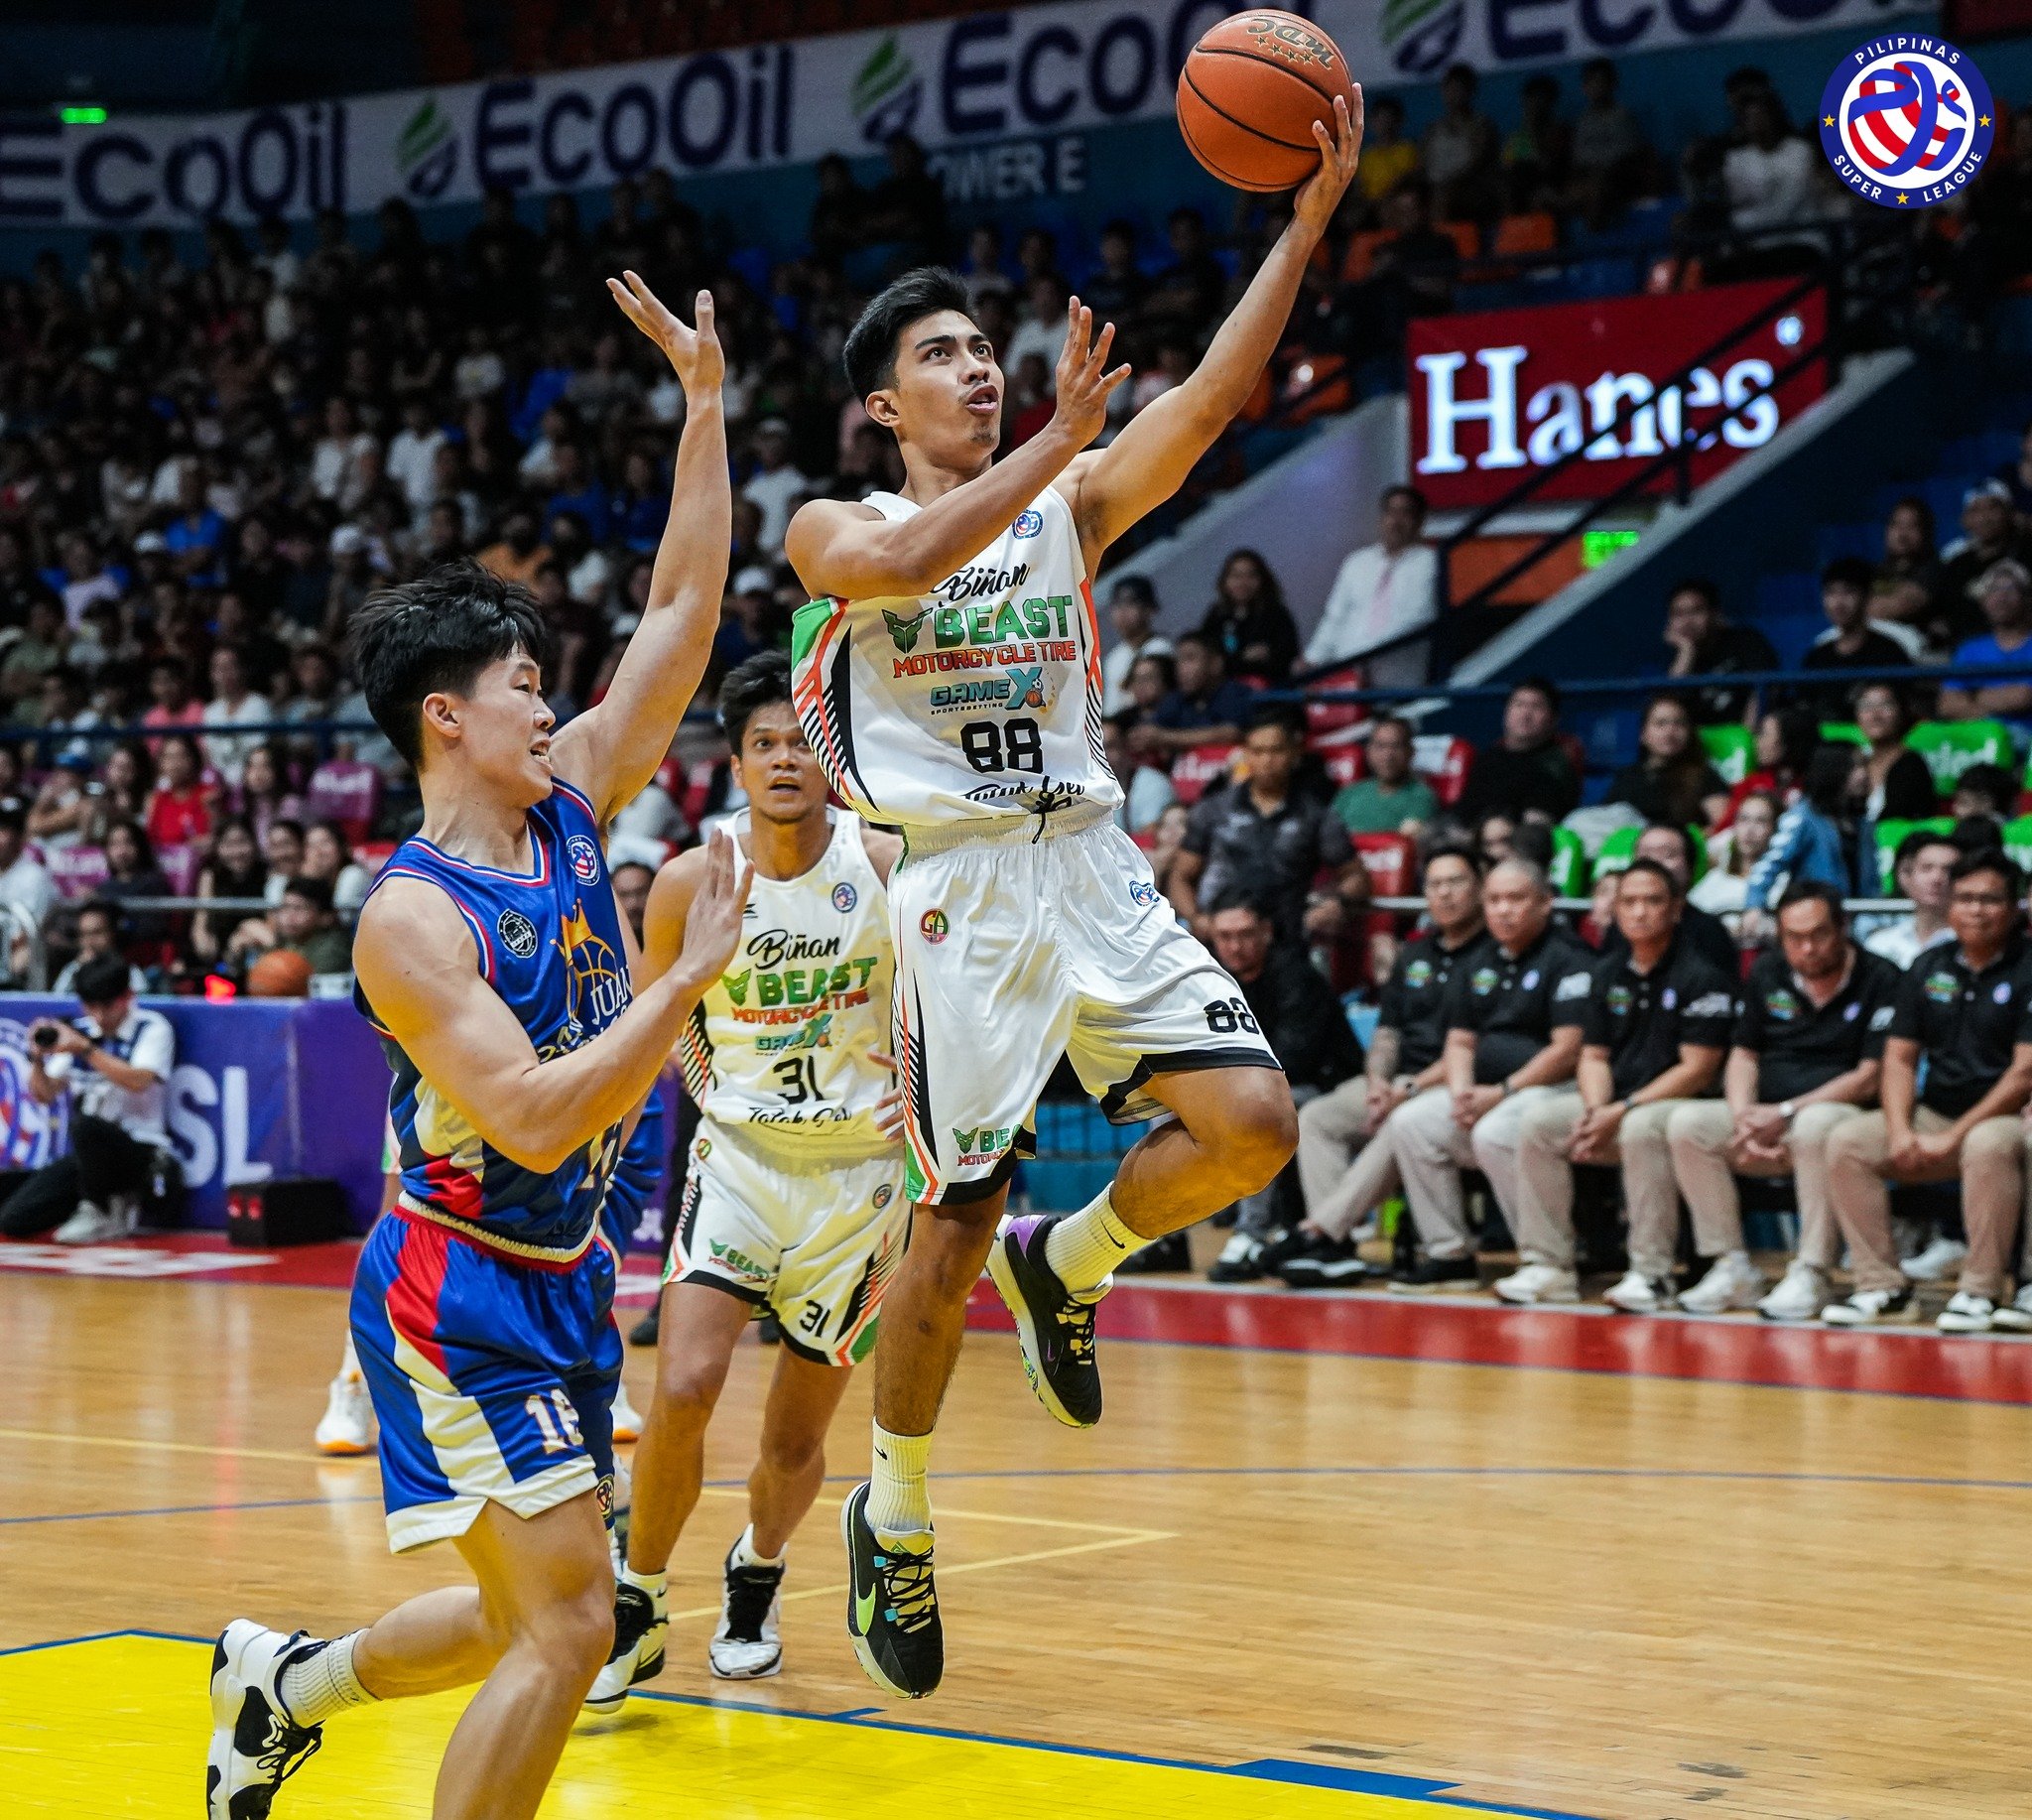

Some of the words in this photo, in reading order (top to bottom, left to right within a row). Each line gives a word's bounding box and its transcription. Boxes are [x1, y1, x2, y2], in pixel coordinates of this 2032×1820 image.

[476, 45, 792, 191] EcoOil
[0, 102, 344, 221] EcoOil
[1415, 344, 1780, 474] Hanes
[930, 563, 1030, 606] Biñan
[935, 595, 1073, 648] BEAST
[893, 643, 1036, 678] MOTORCYCLE
[1037, 641, 1076, 662] TIRE
[931, 703, 1003, 715] SPORTSBETTING
[960, 717, 1044, 775] 88
[746, 929, 840, 971] Biñan
[1204, 997, 1259, 1035] 88
[772, 1055, 825, 1105] 31
[800, 1300, 831, 1338] 31
